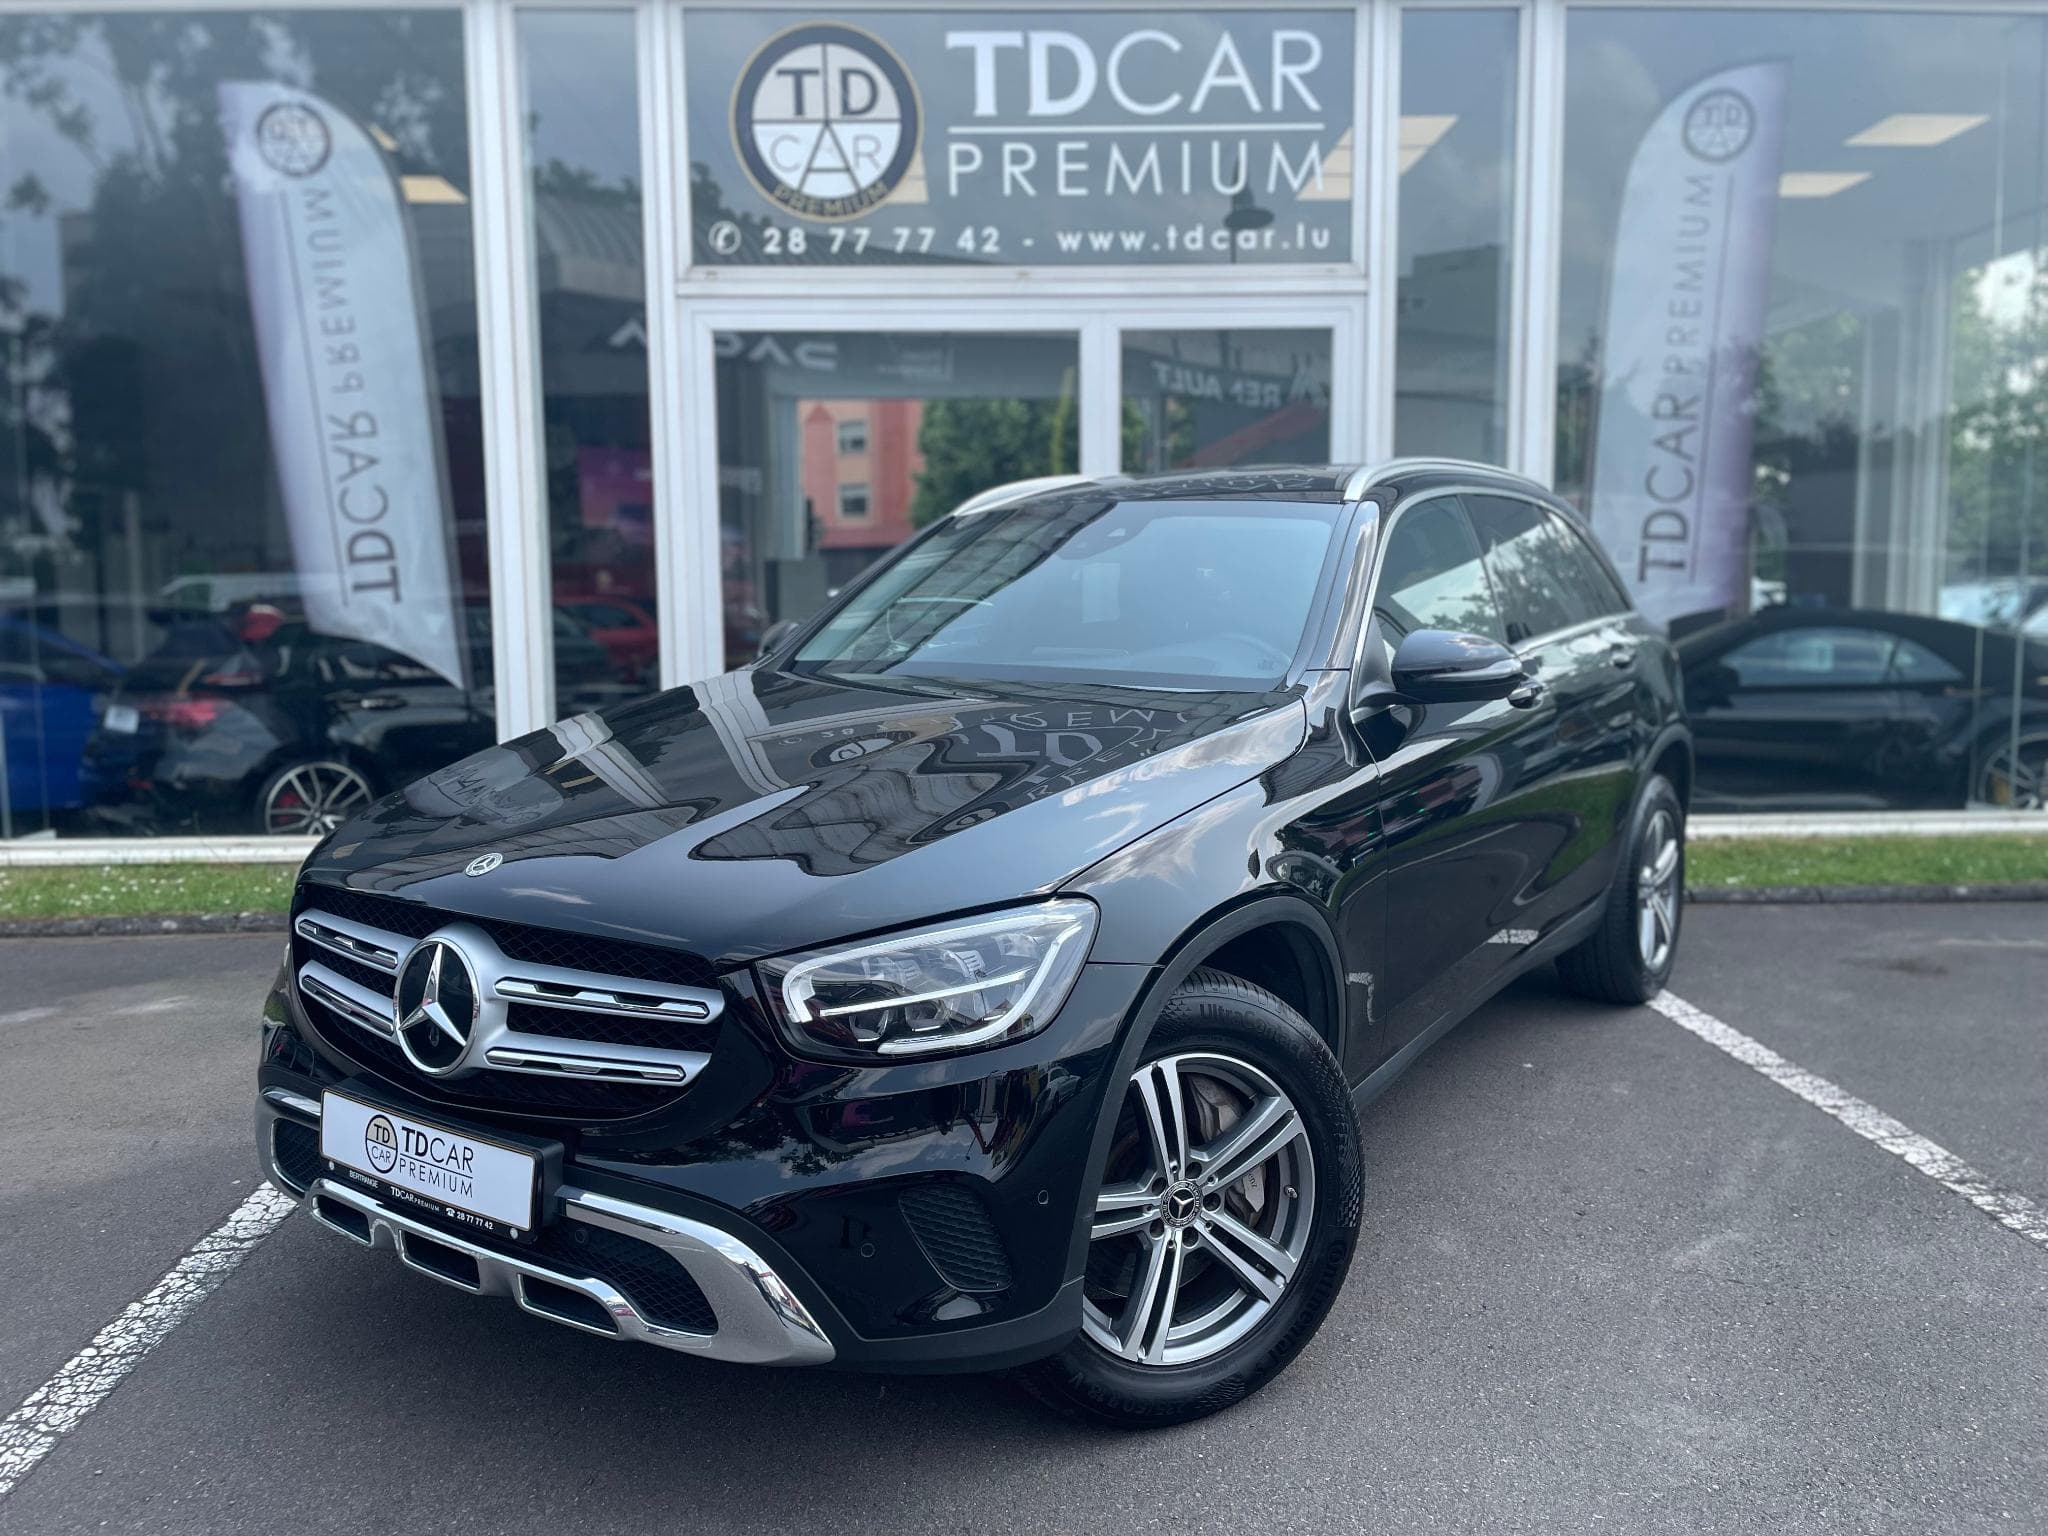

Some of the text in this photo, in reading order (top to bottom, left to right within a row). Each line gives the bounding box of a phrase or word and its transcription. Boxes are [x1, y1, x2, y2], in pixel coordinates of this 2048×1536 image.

[945, 30, 1324, 116] TDCAR
[948, 141, 1324, 196] PREMIUM
[763, 227, 807, 254] 28
[830, 227, 870, 253] 77
[893, 227, 935, 253] 77
[957, 227, 1001, 253] 42
[1057, 223, 1331, 252] www.tdcar.lu
[1637, 172, 1713, 584] TDCAR PREMIUM
[371, 1145, 391, 1164] CAR
[373, 1123, 391, 1145] TD
[401, 1126, 474, 1173] TDCAR
[399, 1158, 473, 1198] PREMIUM
